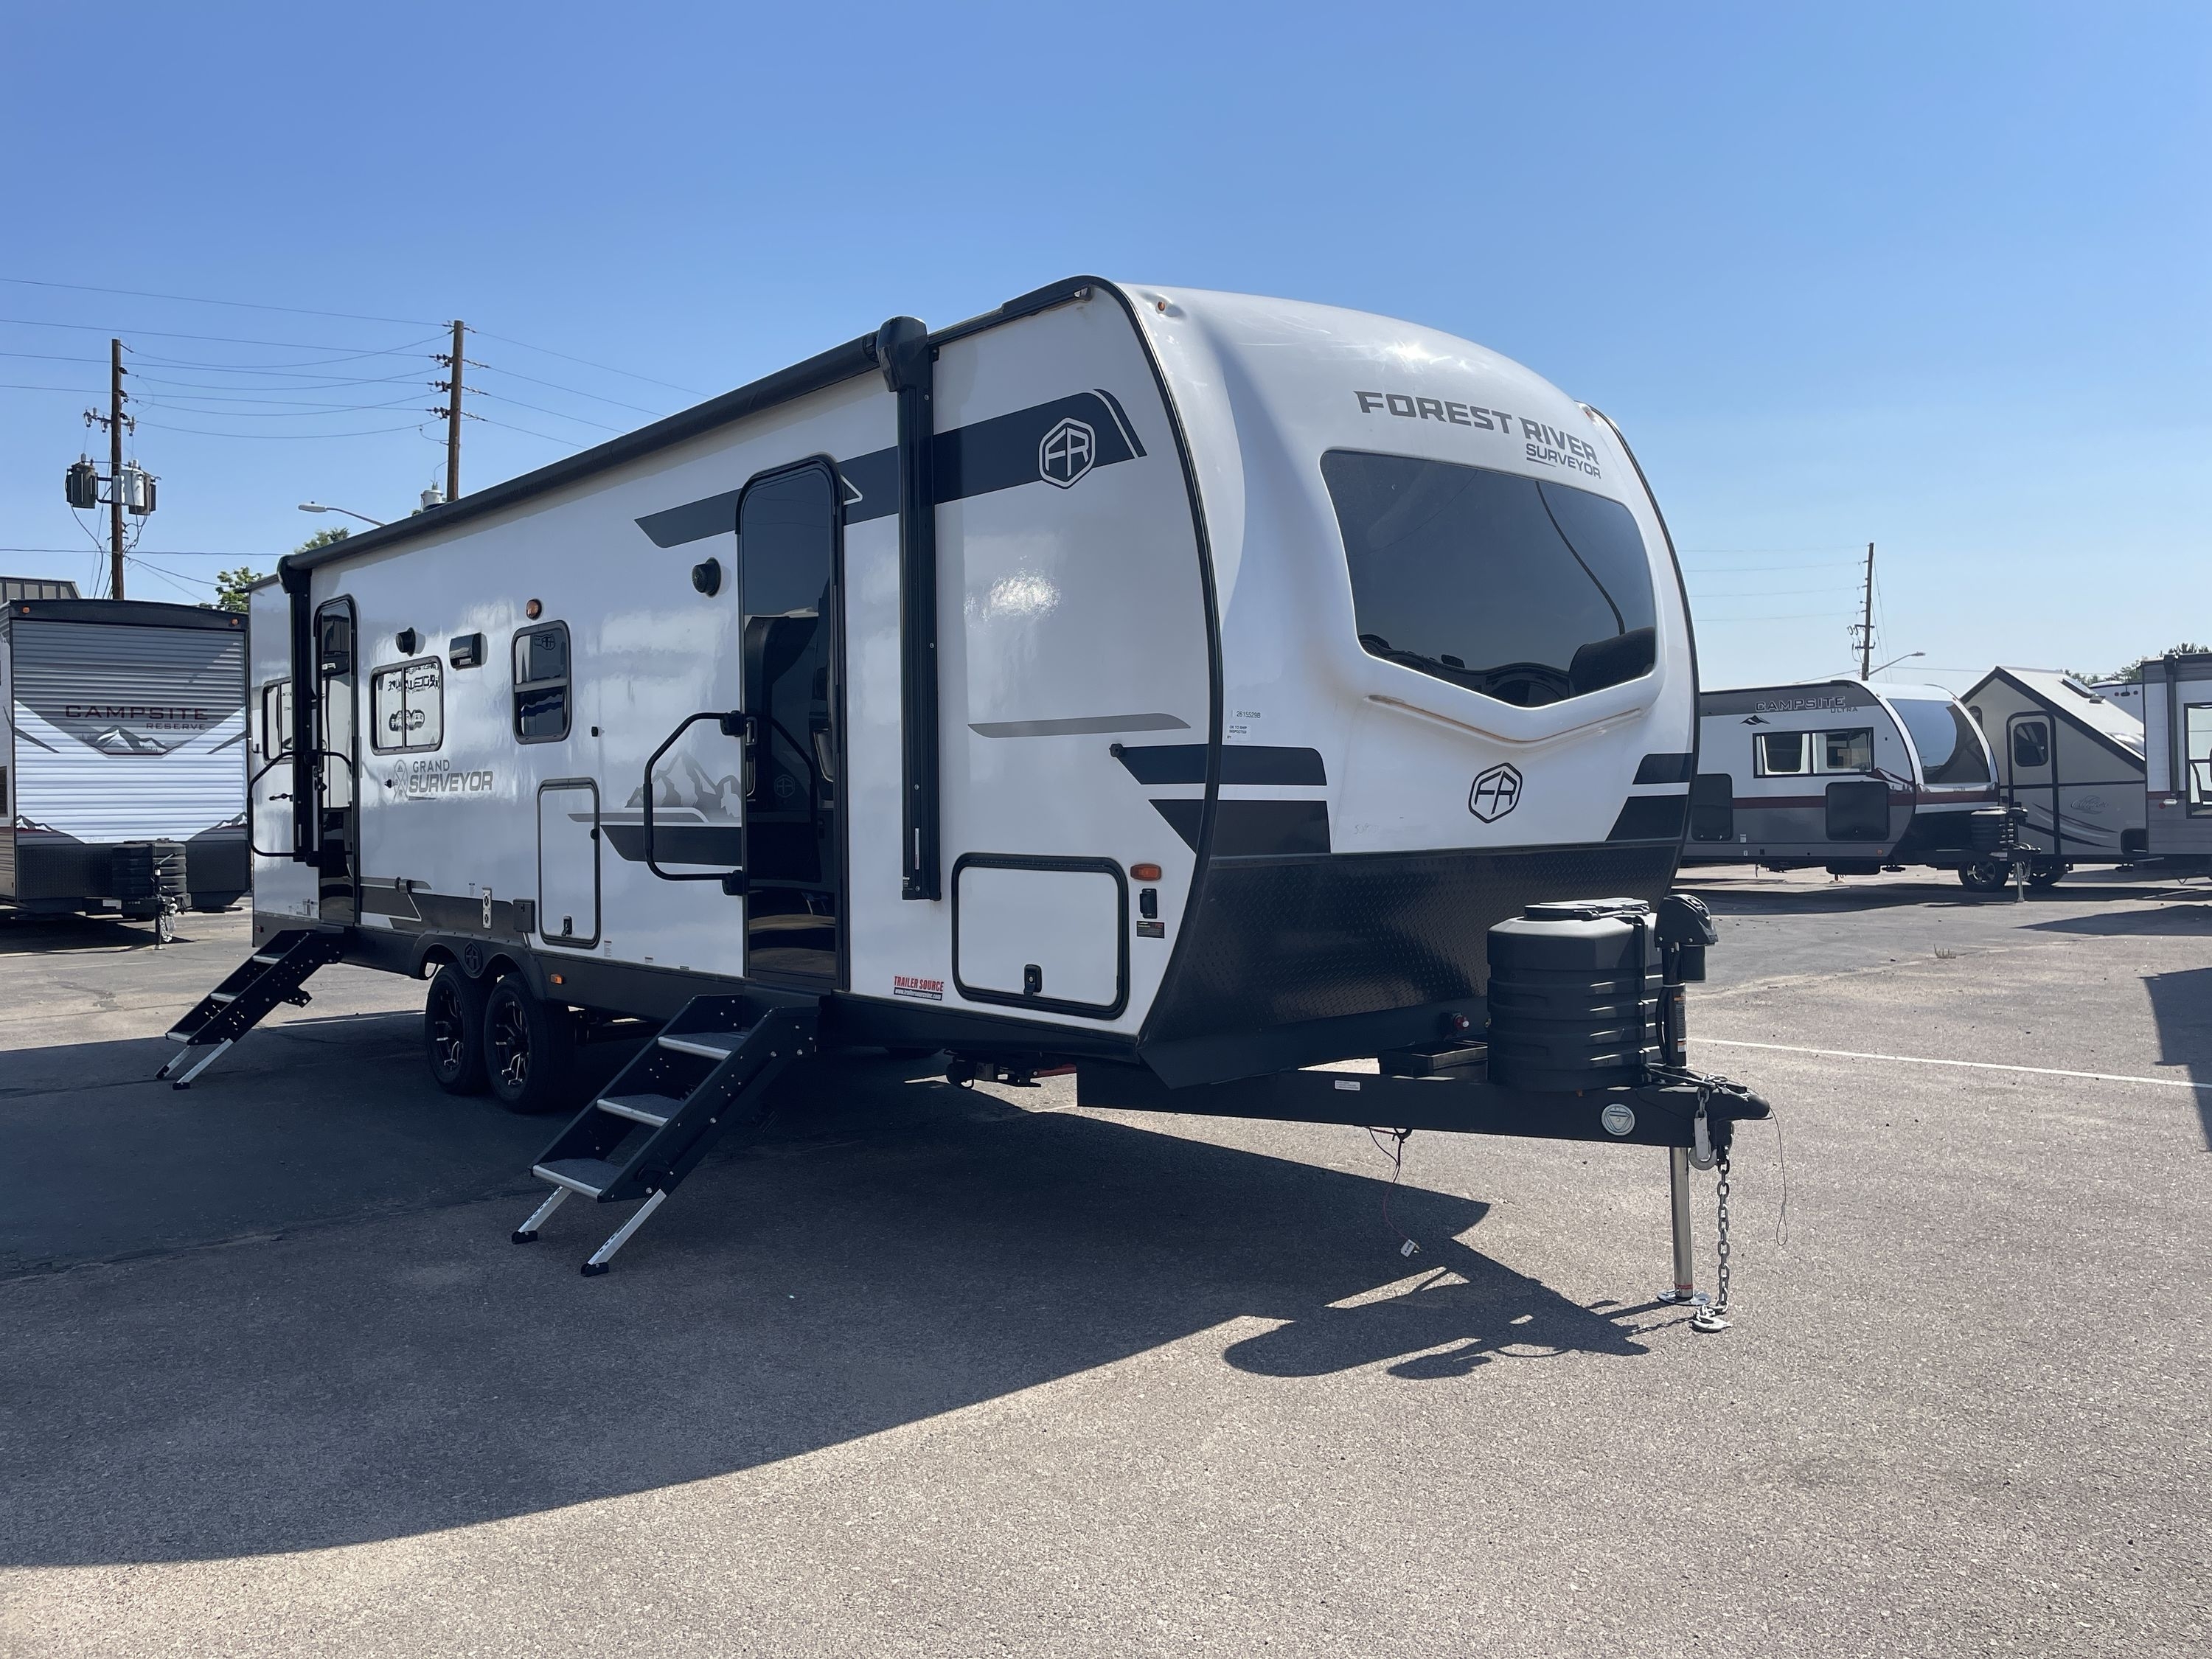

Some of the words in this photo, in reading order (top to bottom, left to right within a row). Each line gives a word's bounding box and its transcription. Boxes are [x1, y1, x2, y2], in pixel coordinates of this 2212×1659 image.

[1353, 391, 1512, 434] FOREST
[1518, 417, 1599, 465] RIVER
[1526, 443, 1601, 479] SURVEYOR
[65, 705, 209, 720] CAMPSITE
[1756, 696, 1846, 712] CAMPSITE
[412, 759, 450, 773] GRAND
[409, 771, 493, 793] SURVEYOR
[894, 975, 919, 989] TRAILER
[919, 979, 944, 992] SOURCE
